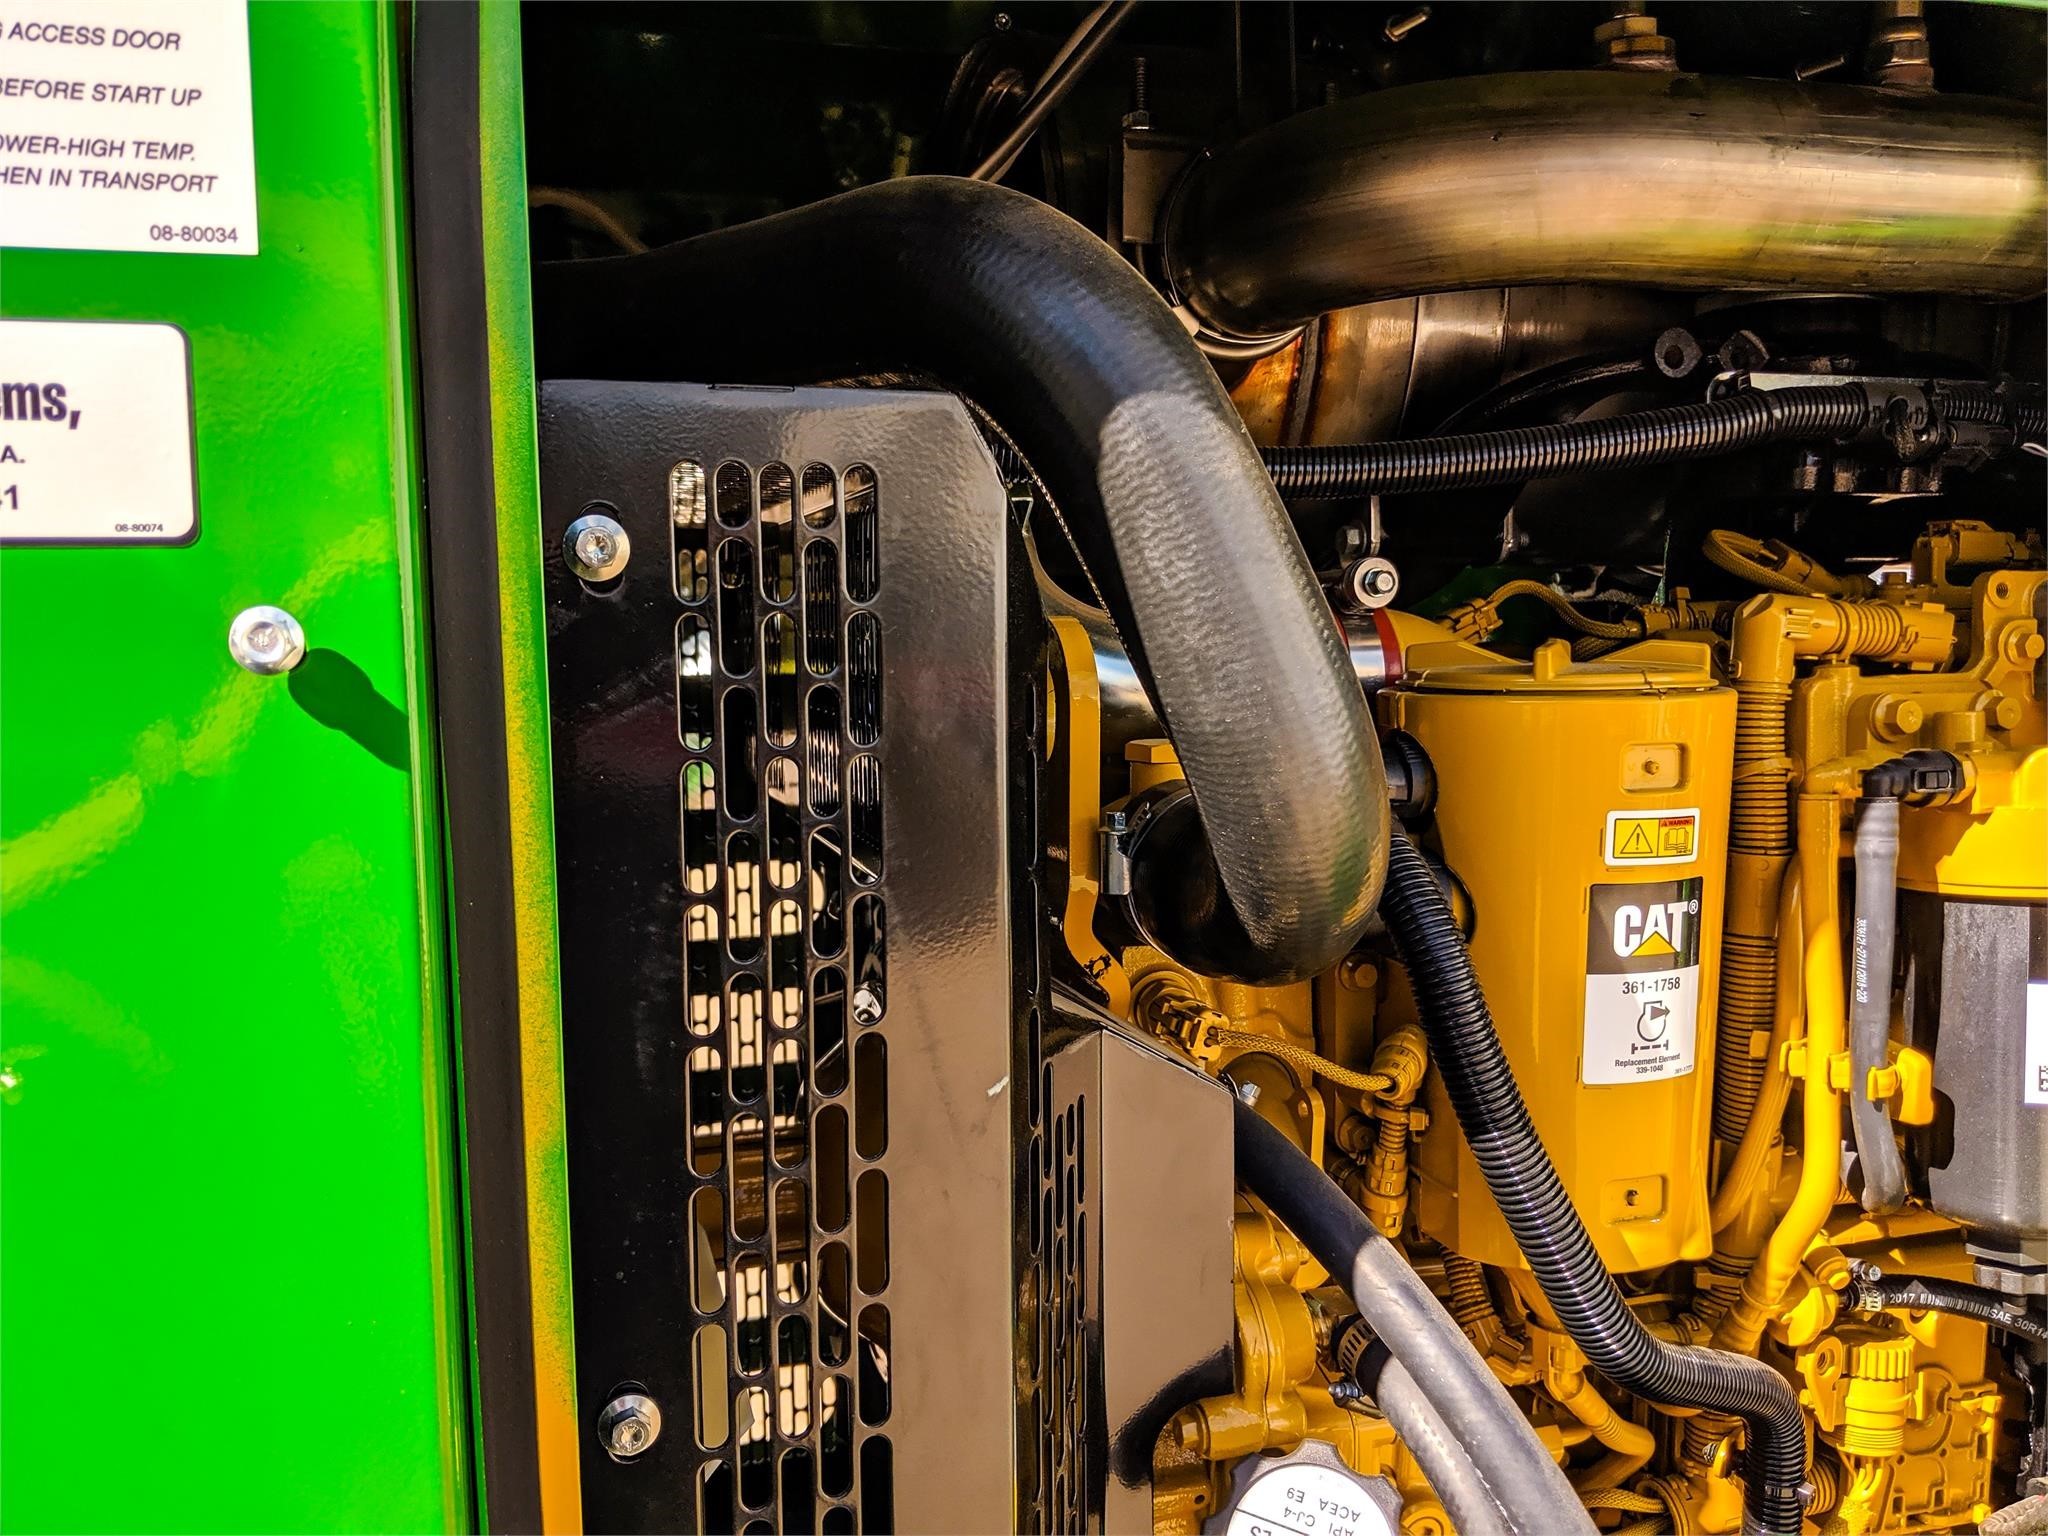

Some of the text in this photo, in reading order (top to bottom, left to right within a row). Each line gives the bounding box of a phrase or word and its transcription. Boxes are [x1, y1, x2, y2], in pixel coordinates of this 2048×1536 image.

[8, 22, 106, 46] ACCESS
[112, 29, 182, 51] DOOR
[0, 78, 203, 107] EFORE START UP
[0, 134, 196, 162] WER-HIGH TEMP.
[49, 168, 73, 188] IN
[79, 170, 219, 194] TRANSPORT
[149, 224, 239, 244] 08-80034
[0, 381, 82, 430] ms,
[114, 523, 164, 533] 08-80074
[1621, 976, 1681, 995] 361-1758
[1614, 1053, 1681, 1068] Replacement Element
[1635, 1064, 1664, 1074] 339-1048
[1889, 1293, 1916, 1304] 2017
[1988, 1308, 2014, 1325] SAE
[1286, 1487, 1362, 1522] ACEA E9
[1283, 1506, 1316, 1527] CJ-4
